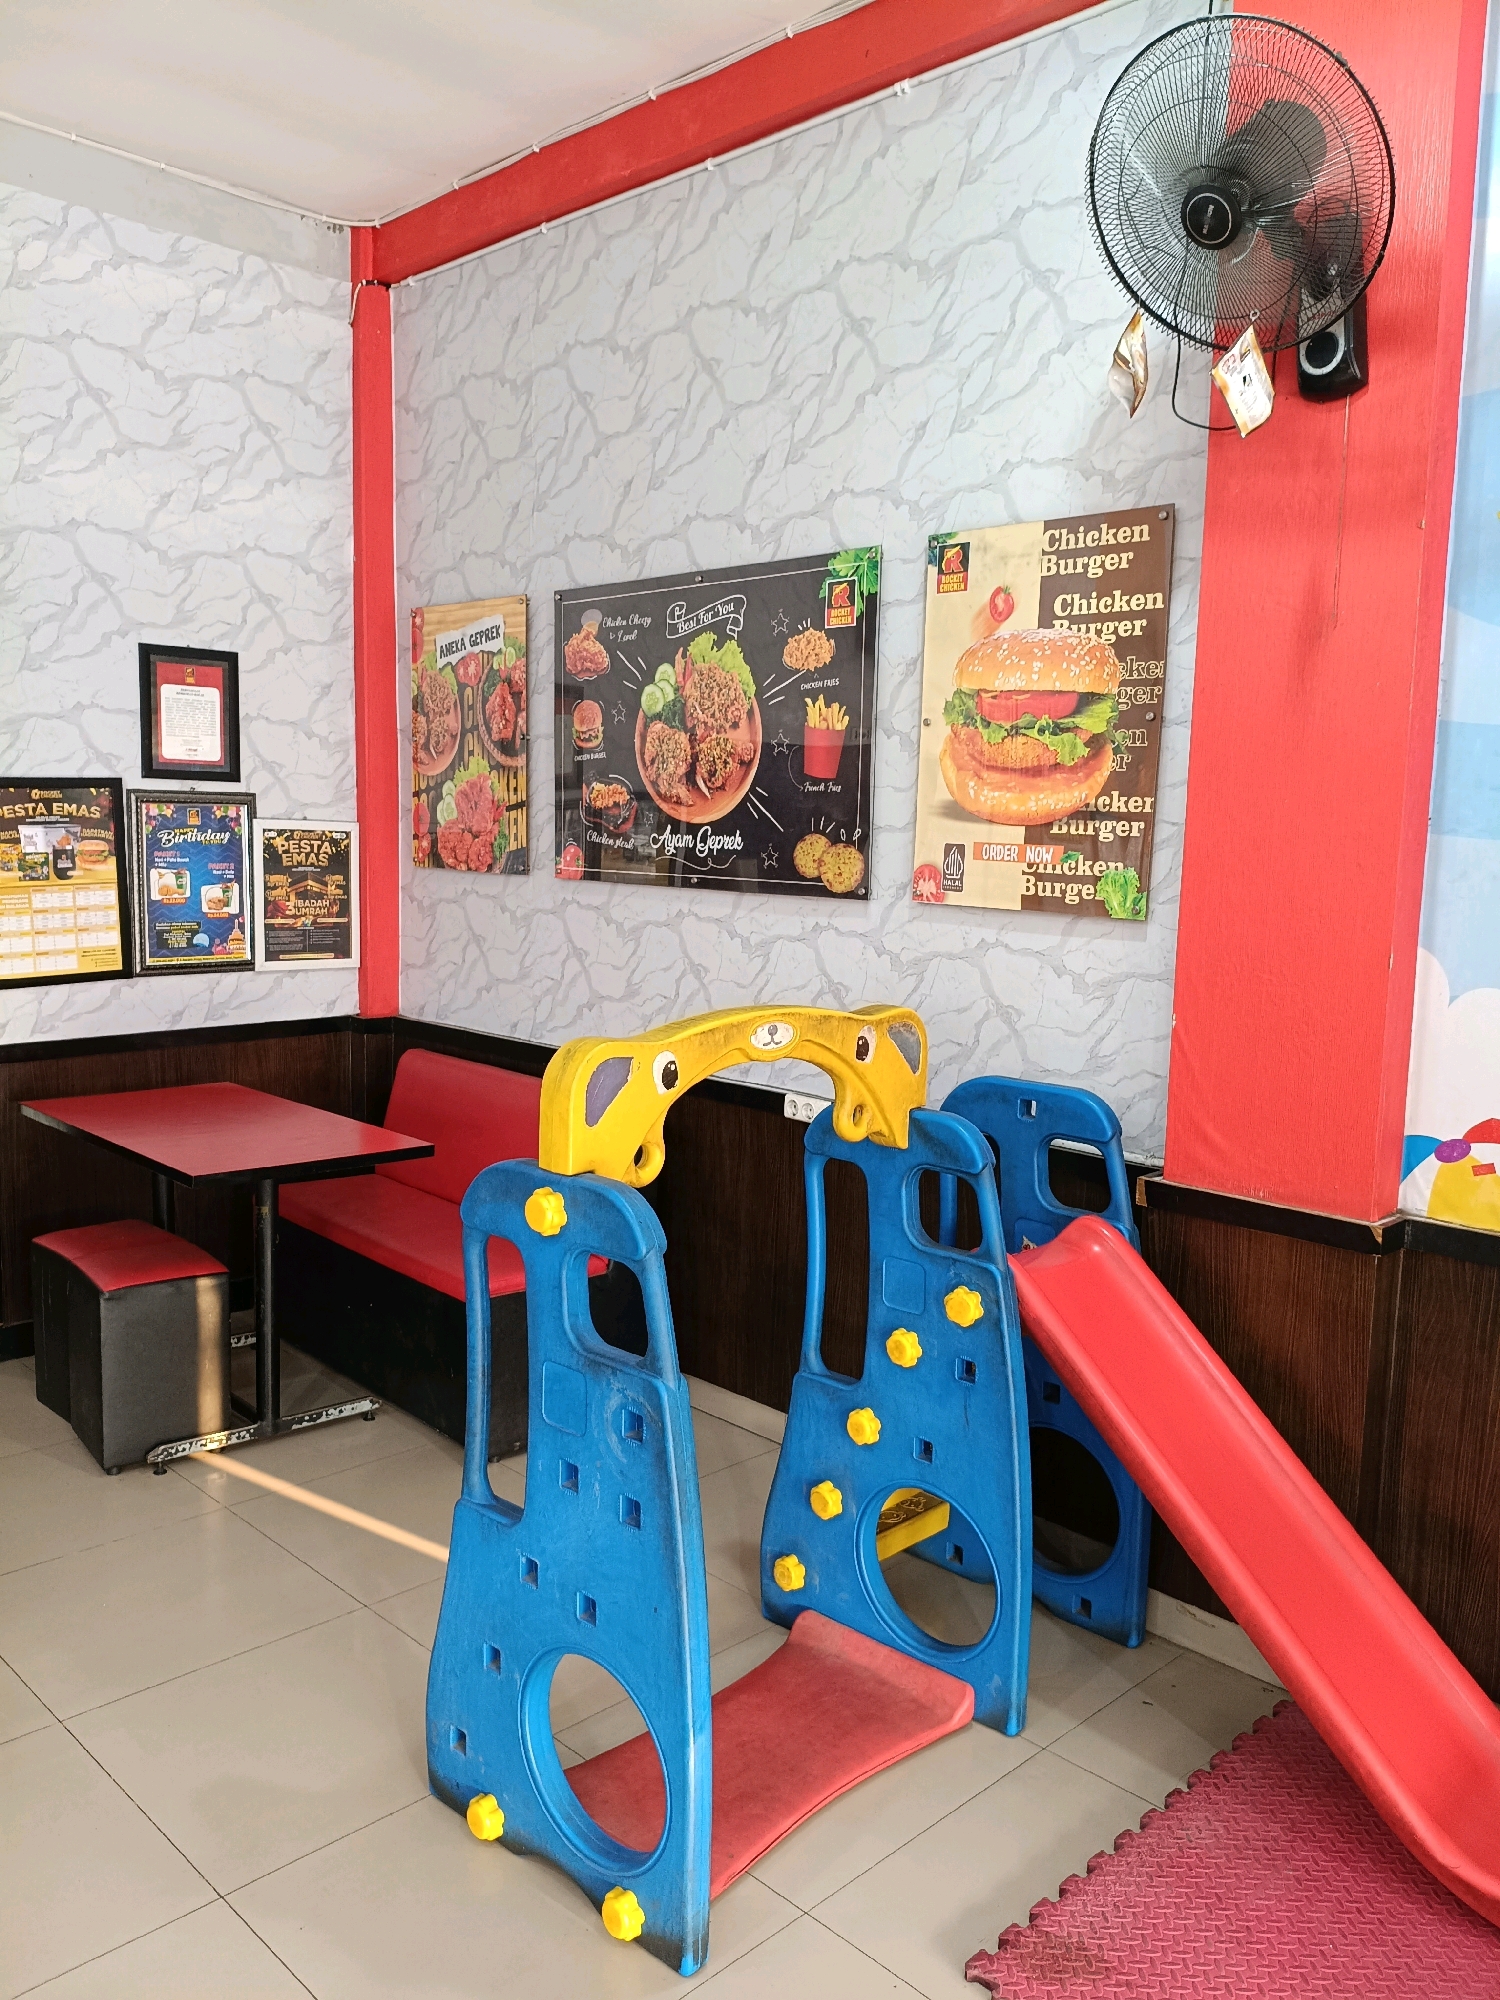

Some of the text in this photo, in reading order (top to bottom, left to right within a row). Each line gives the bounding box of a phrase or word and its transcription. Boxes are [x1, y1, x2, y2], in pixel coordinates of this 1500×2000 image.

[1042, 523, 1150, 552] Chicken
[1041, 552, 1134, 579] Burger
[940, 582, 965, 593] CHICKEN
[1054, 589, 1164, 617] Chicken
[676, 602, 735, 634] Best For You
[831, 607, 851, 617] ROCKET
[602, 616, 627, 628] Chicken
[829, 616, 852, 626] CHICKEN
[440, 624, 501, 660] ANEKA GEPREK
[801, 680, 823, 690] CHICKEN
[574, 753, 590, 761] CHICKEN
[0, 802, 49, 819] ESTA
[52, 802, 101, 819] EMAS
[157, 828, 231, 848] Birthday
[586, 829, 614, 846] Chicken
[1050, 817, 1145, 842] Burger
[277, 839, 333, 855] PESTA
[649, 823, 744, 858] Ayam Geprek
[281, 852, 329, 867] EMAS
[982, 843, 1053, 864] ORDER NOW
[943, 879, 962, 887] HALAL
[1021, 874, 1105, 905] Burge
[285, 899, 330, 915] 3 IBADAH
[295, 907, 328, 916] UMRAH
